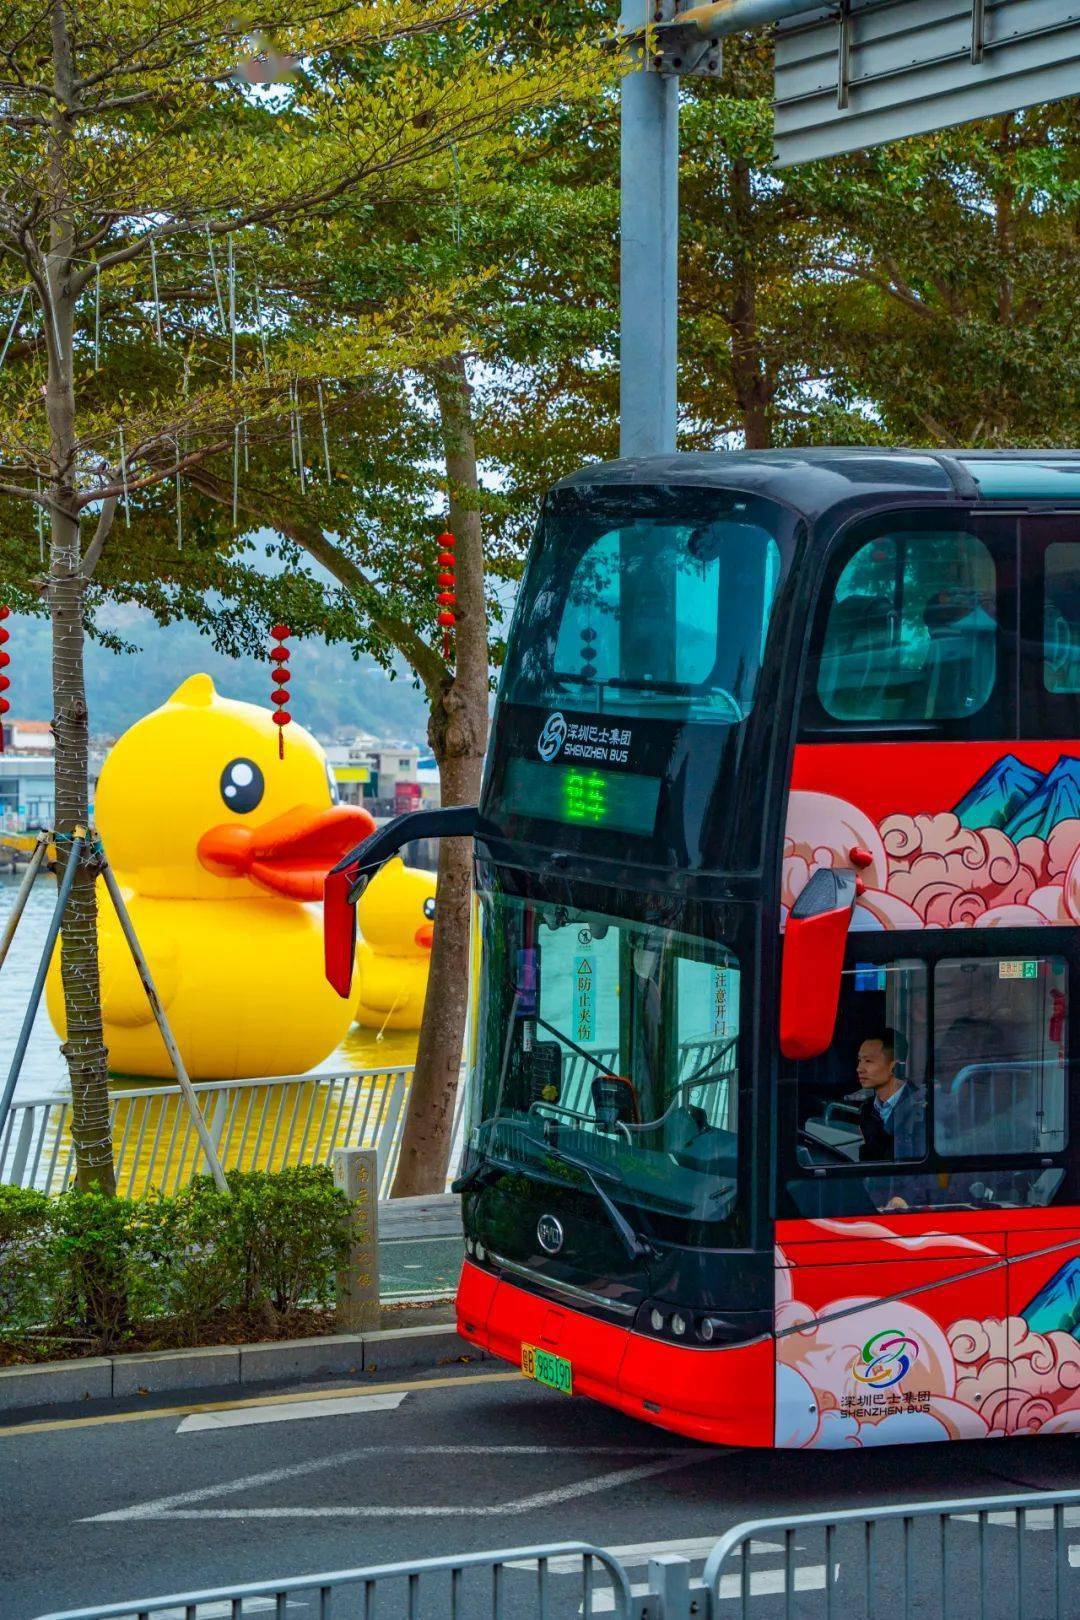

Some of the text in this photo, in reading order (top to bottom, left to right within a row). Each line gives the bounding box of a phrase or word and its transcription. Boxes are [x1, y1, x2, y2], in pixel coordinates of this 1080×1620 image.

[567, 724, 632, 746] 深圳巴士集团
[563, 743, 629, 763] SHENZHEN BUS
[714, 973, 727, 1036] 注意开门
[840, 1391, 931, 1408] 深圳巴士集团
[840, 1404, 931, 1419] SHENZHEN BUS
